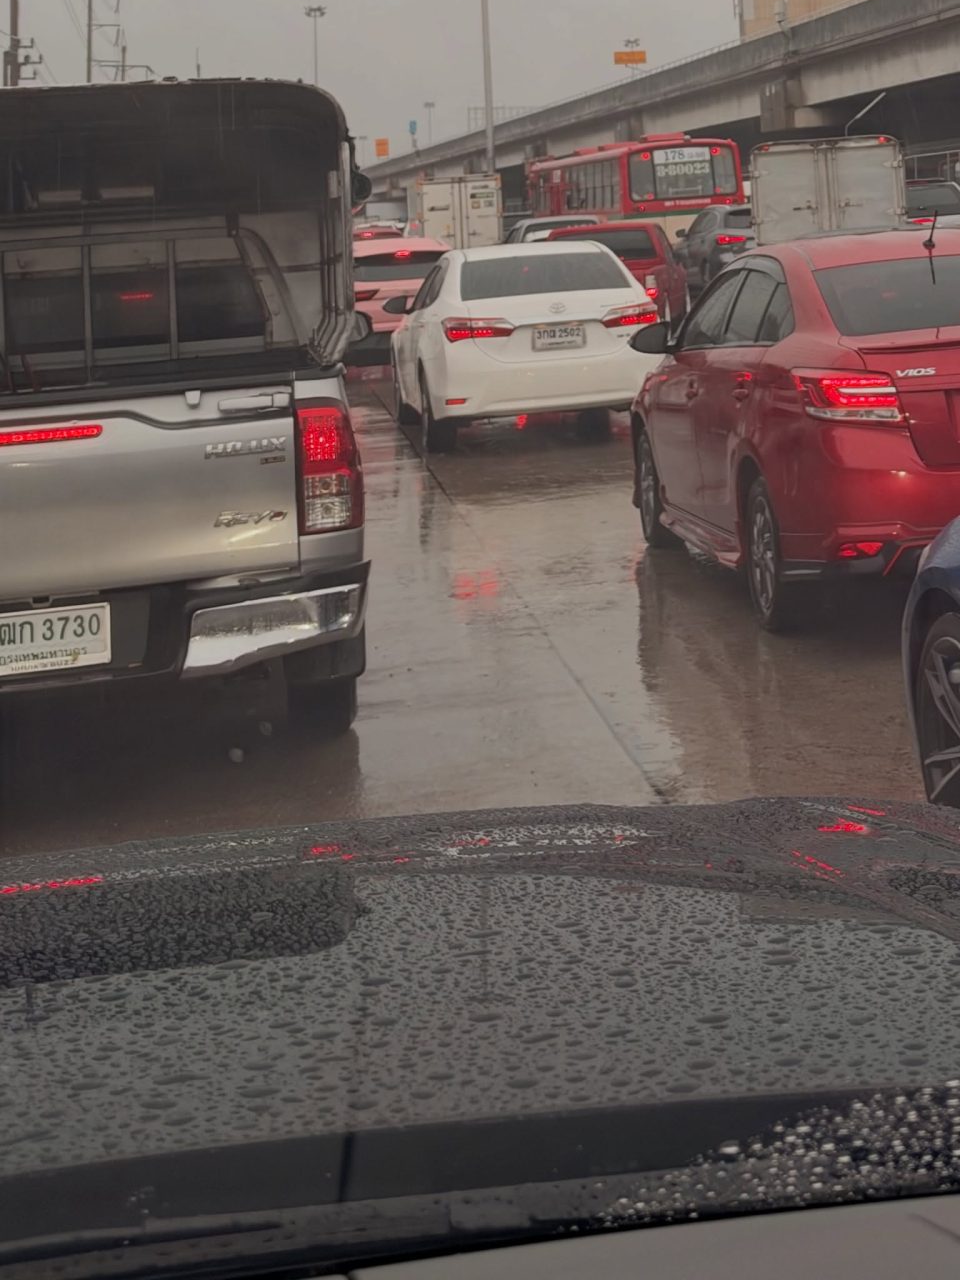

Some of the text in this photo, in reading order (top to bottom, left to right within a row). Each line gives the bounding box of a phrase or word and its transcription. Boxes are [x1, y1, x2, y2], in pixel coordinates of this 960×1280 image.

[663, 149, 686, 161] 178
[896, 367, 936, 377] VIOS
[42, 613, 100, 641] 3730
